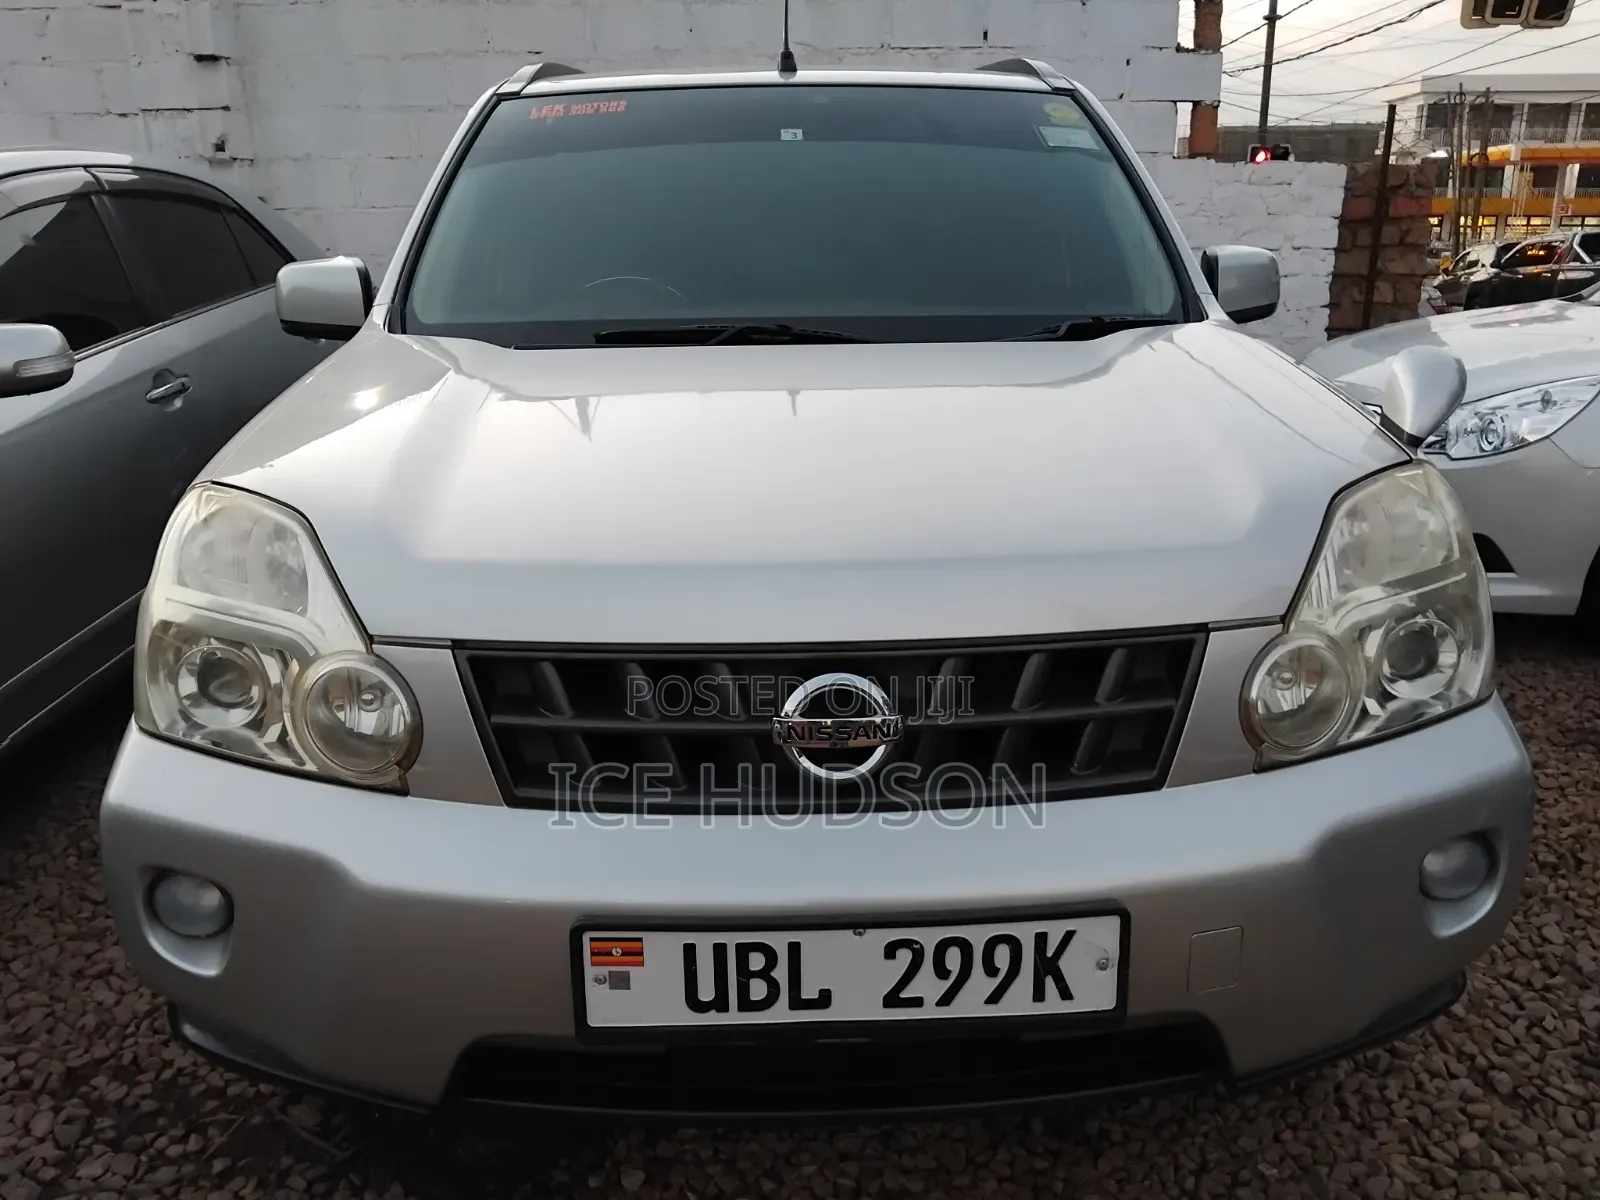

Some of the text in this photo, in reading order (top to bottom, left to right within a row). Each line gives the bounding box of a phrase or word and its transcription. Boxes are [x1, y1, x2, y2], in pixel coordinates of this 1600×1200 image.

[571, 100, 627, 112] MOTORS
[787, 722, 891, 742] NISSAN
[682, 929, 1078, 1014] UBL 299K
